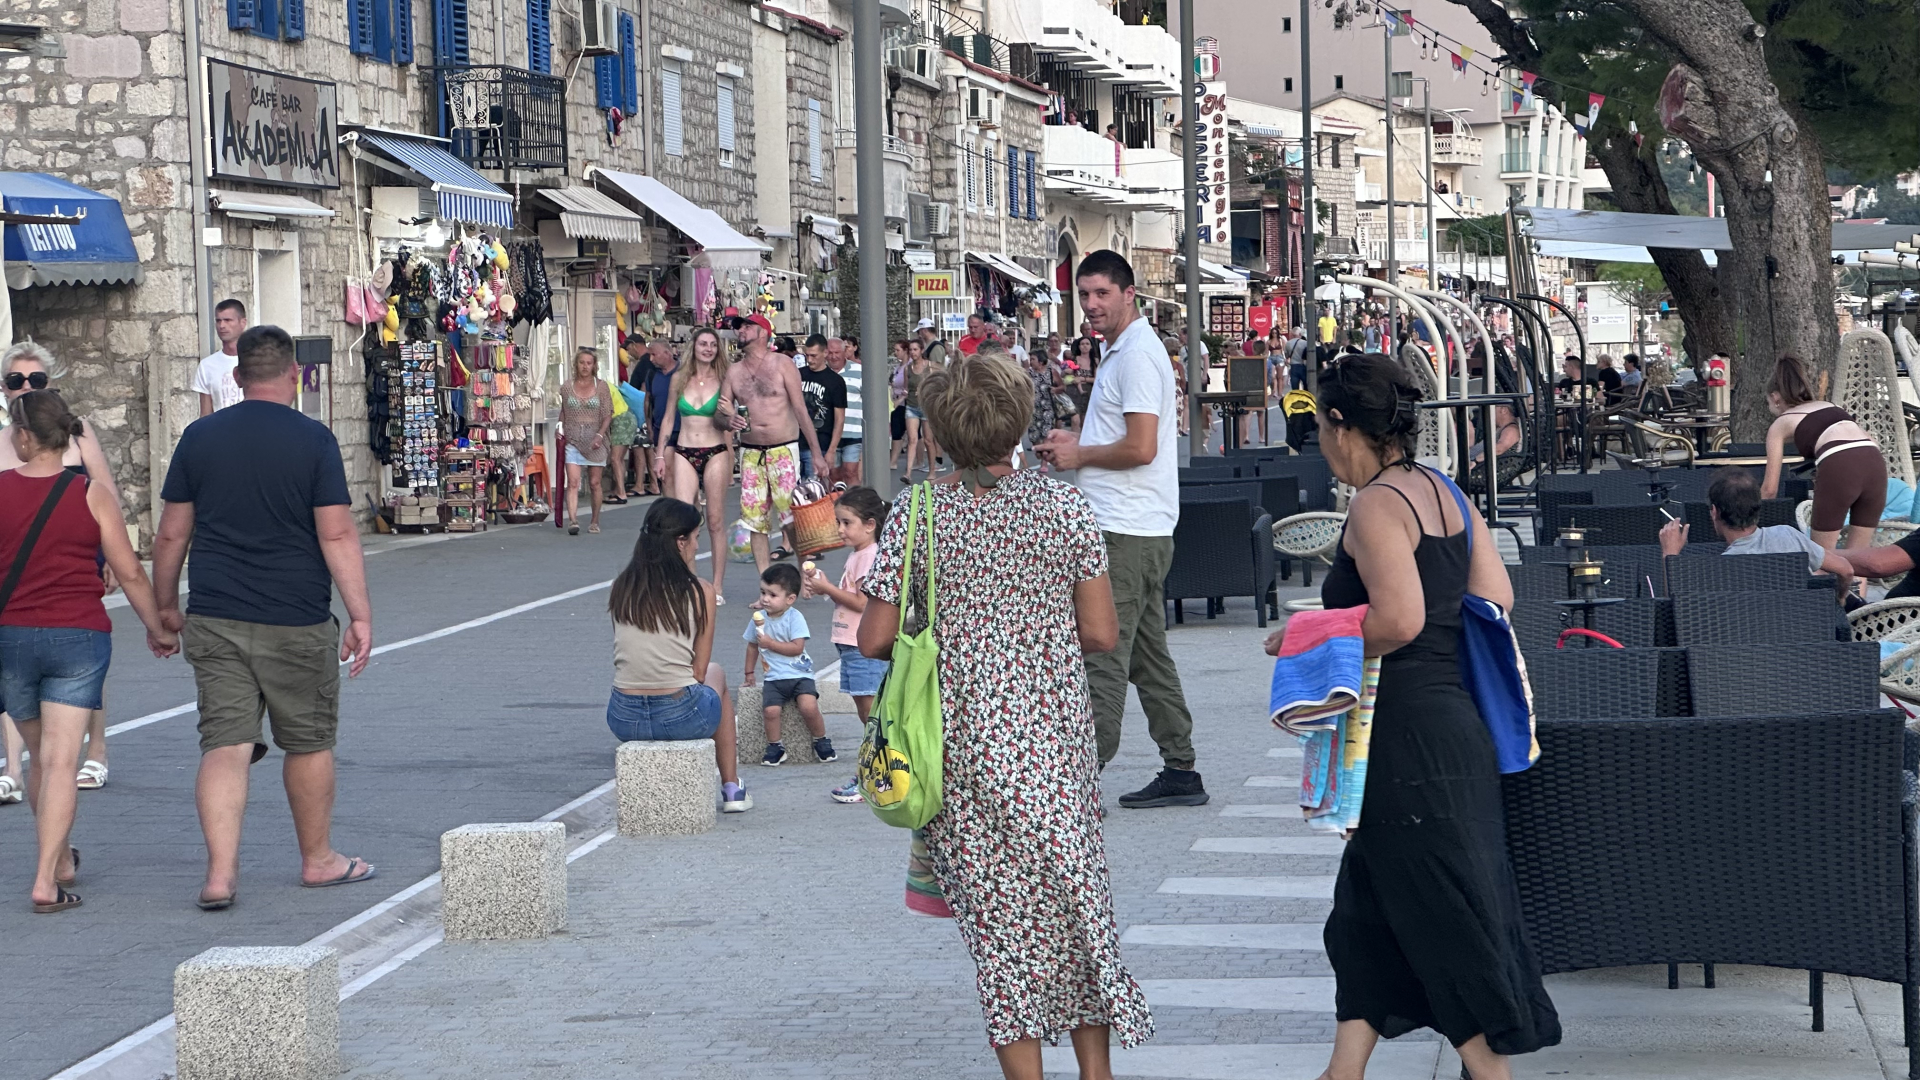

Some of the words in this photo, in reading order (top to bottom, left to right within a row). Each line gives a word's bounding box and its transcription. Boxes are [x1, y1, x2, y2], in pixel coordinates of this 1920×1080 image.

[250, 86, 278, 108] CAFE
[281, 93, 302, 113] BAR
[222, 89, 335, 177] AKADEMIJA
[1200, 93, 1226, 242] Montenegro
[917, 278, 949, 291] PIZZA
[801, 380, 826, 400] HAOTIC
